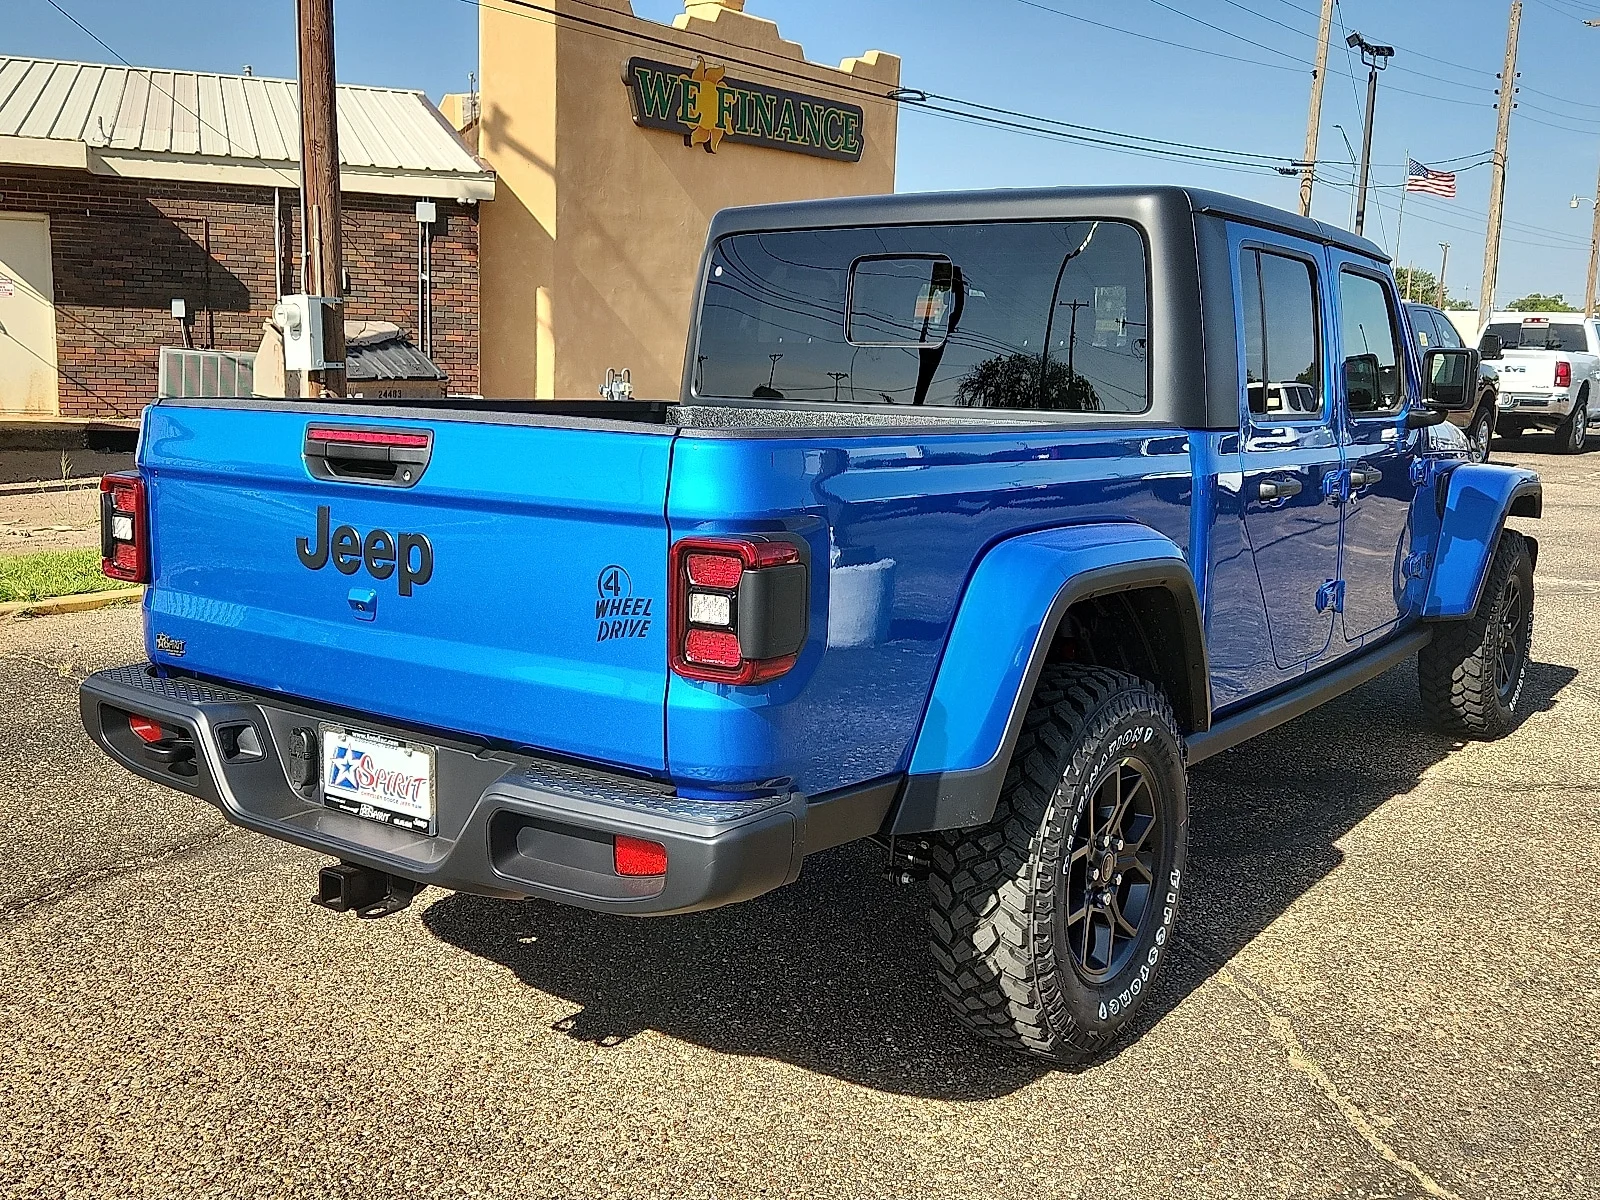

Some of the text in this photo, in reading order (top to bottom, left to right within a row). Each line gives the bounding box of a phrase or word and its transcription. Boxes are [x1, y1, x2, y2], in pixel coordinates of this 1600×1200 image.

[634, 66, 860, 154] WE FINANCE
[295, 505, 433, 597] Jeep
[595, 597, 654, 620] WHEEL
[597, 618, 652, 642] DRIVE
